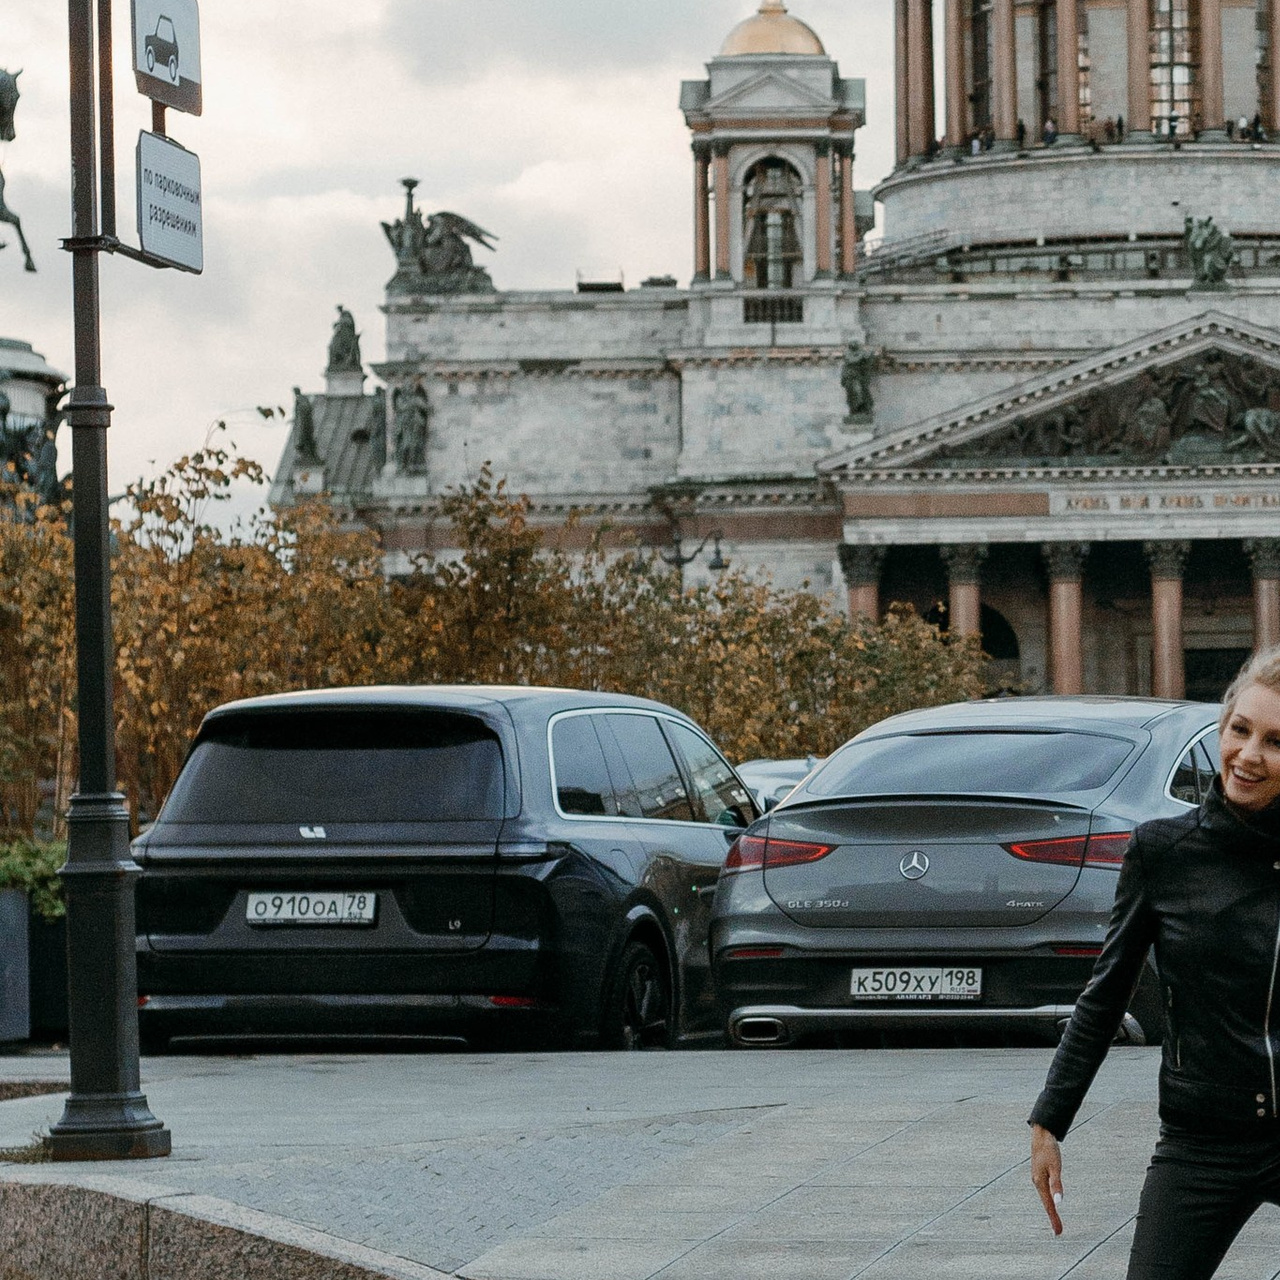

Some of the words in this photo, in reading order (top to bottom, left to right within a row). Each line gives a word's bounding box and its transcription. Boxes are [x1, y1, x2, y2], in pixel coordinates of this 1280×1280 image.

[144, 168, 153, 185] по
[149, 203, 198, 238] разрешениям
[346, 894, 367, 911] 78
[788, 900, 812, 909] GLE
[815, 899, 850, 908] 350d
[448, 920, 462, 930] L9
[945, 970, 976, 987] 198
